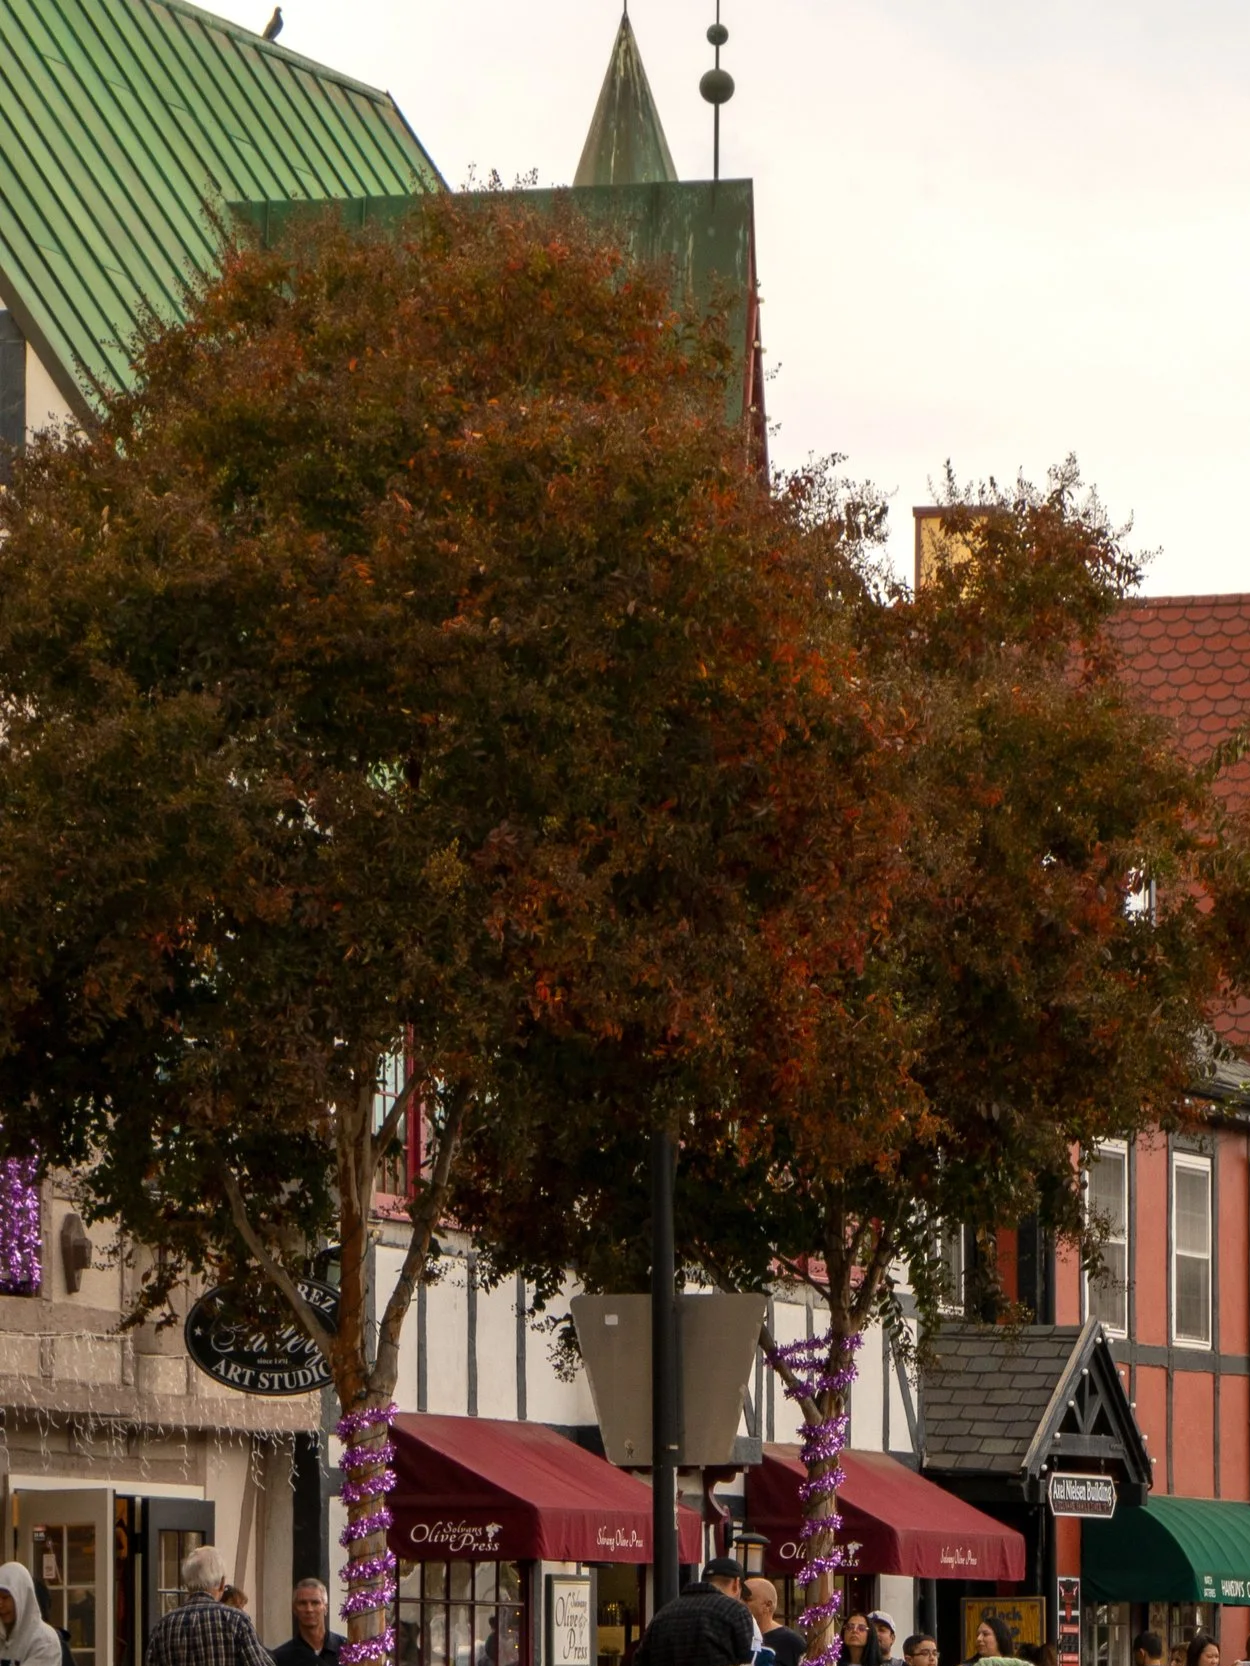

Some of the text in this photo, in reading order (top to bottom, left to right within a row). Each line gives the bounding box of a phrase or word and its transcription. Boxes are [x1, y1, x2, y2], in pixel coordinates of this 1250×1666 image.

[211, 1358, 256, 1387] ART
[1053, 1479, 1112, 1507] Axel Nielsen Building
[410, 1521, 457, 1544] Olive
[443, 1520, 482, 1537] Solvang
[596, 1526, 644, 1552] Solvang Olive Press
[449, 1532, 500, 1552] Press
[779, 1541, 807, 1560] Oli
[838, 1558, 859, 1568] ess
[954, 1547, 965, 1565] Olive
[965, 1549, 978, 1566] Press
[555, 1592, 579, 1627] Olive
[570, 1591, 588, 1611] Solvang
[563, 1628, 588, 1660] Press
